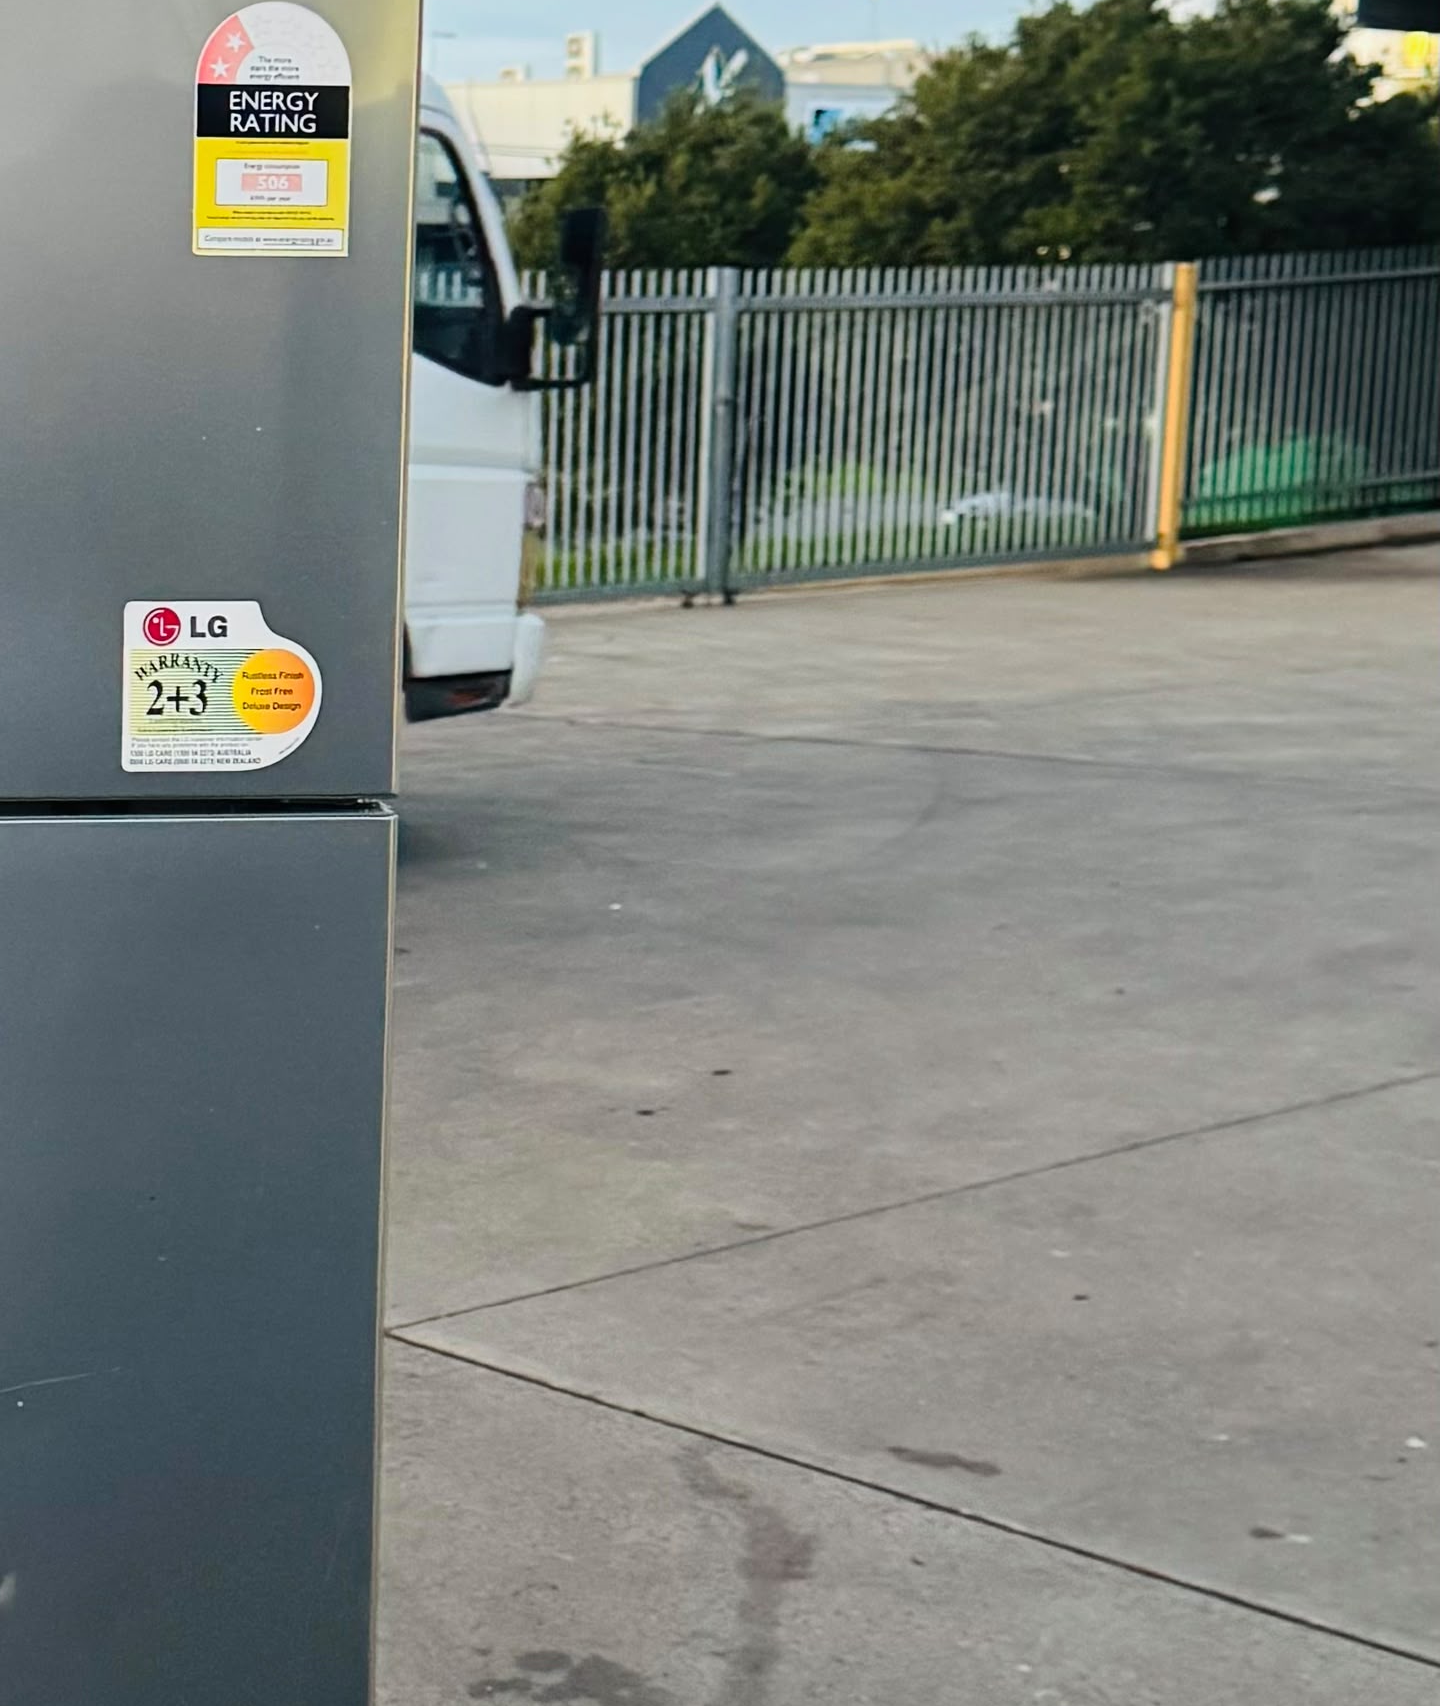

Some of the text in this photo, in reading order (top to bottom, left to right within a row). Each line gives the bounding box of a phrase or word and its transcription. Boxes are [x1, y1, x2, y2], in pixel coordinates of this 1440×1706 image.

[229, 90, 320, 111] ENERGY
[230, 112, 317, 134] RATING
[257, 175, 289, 190] 506
[190, 615, 228, 638] LG
[134, 653, 224, 683] WARRANTY
[146, 679, 208, 715] 2+3
[250, 687, 294, 696] Frost Free
[242, 701, 302, 711] Deluxe Design
